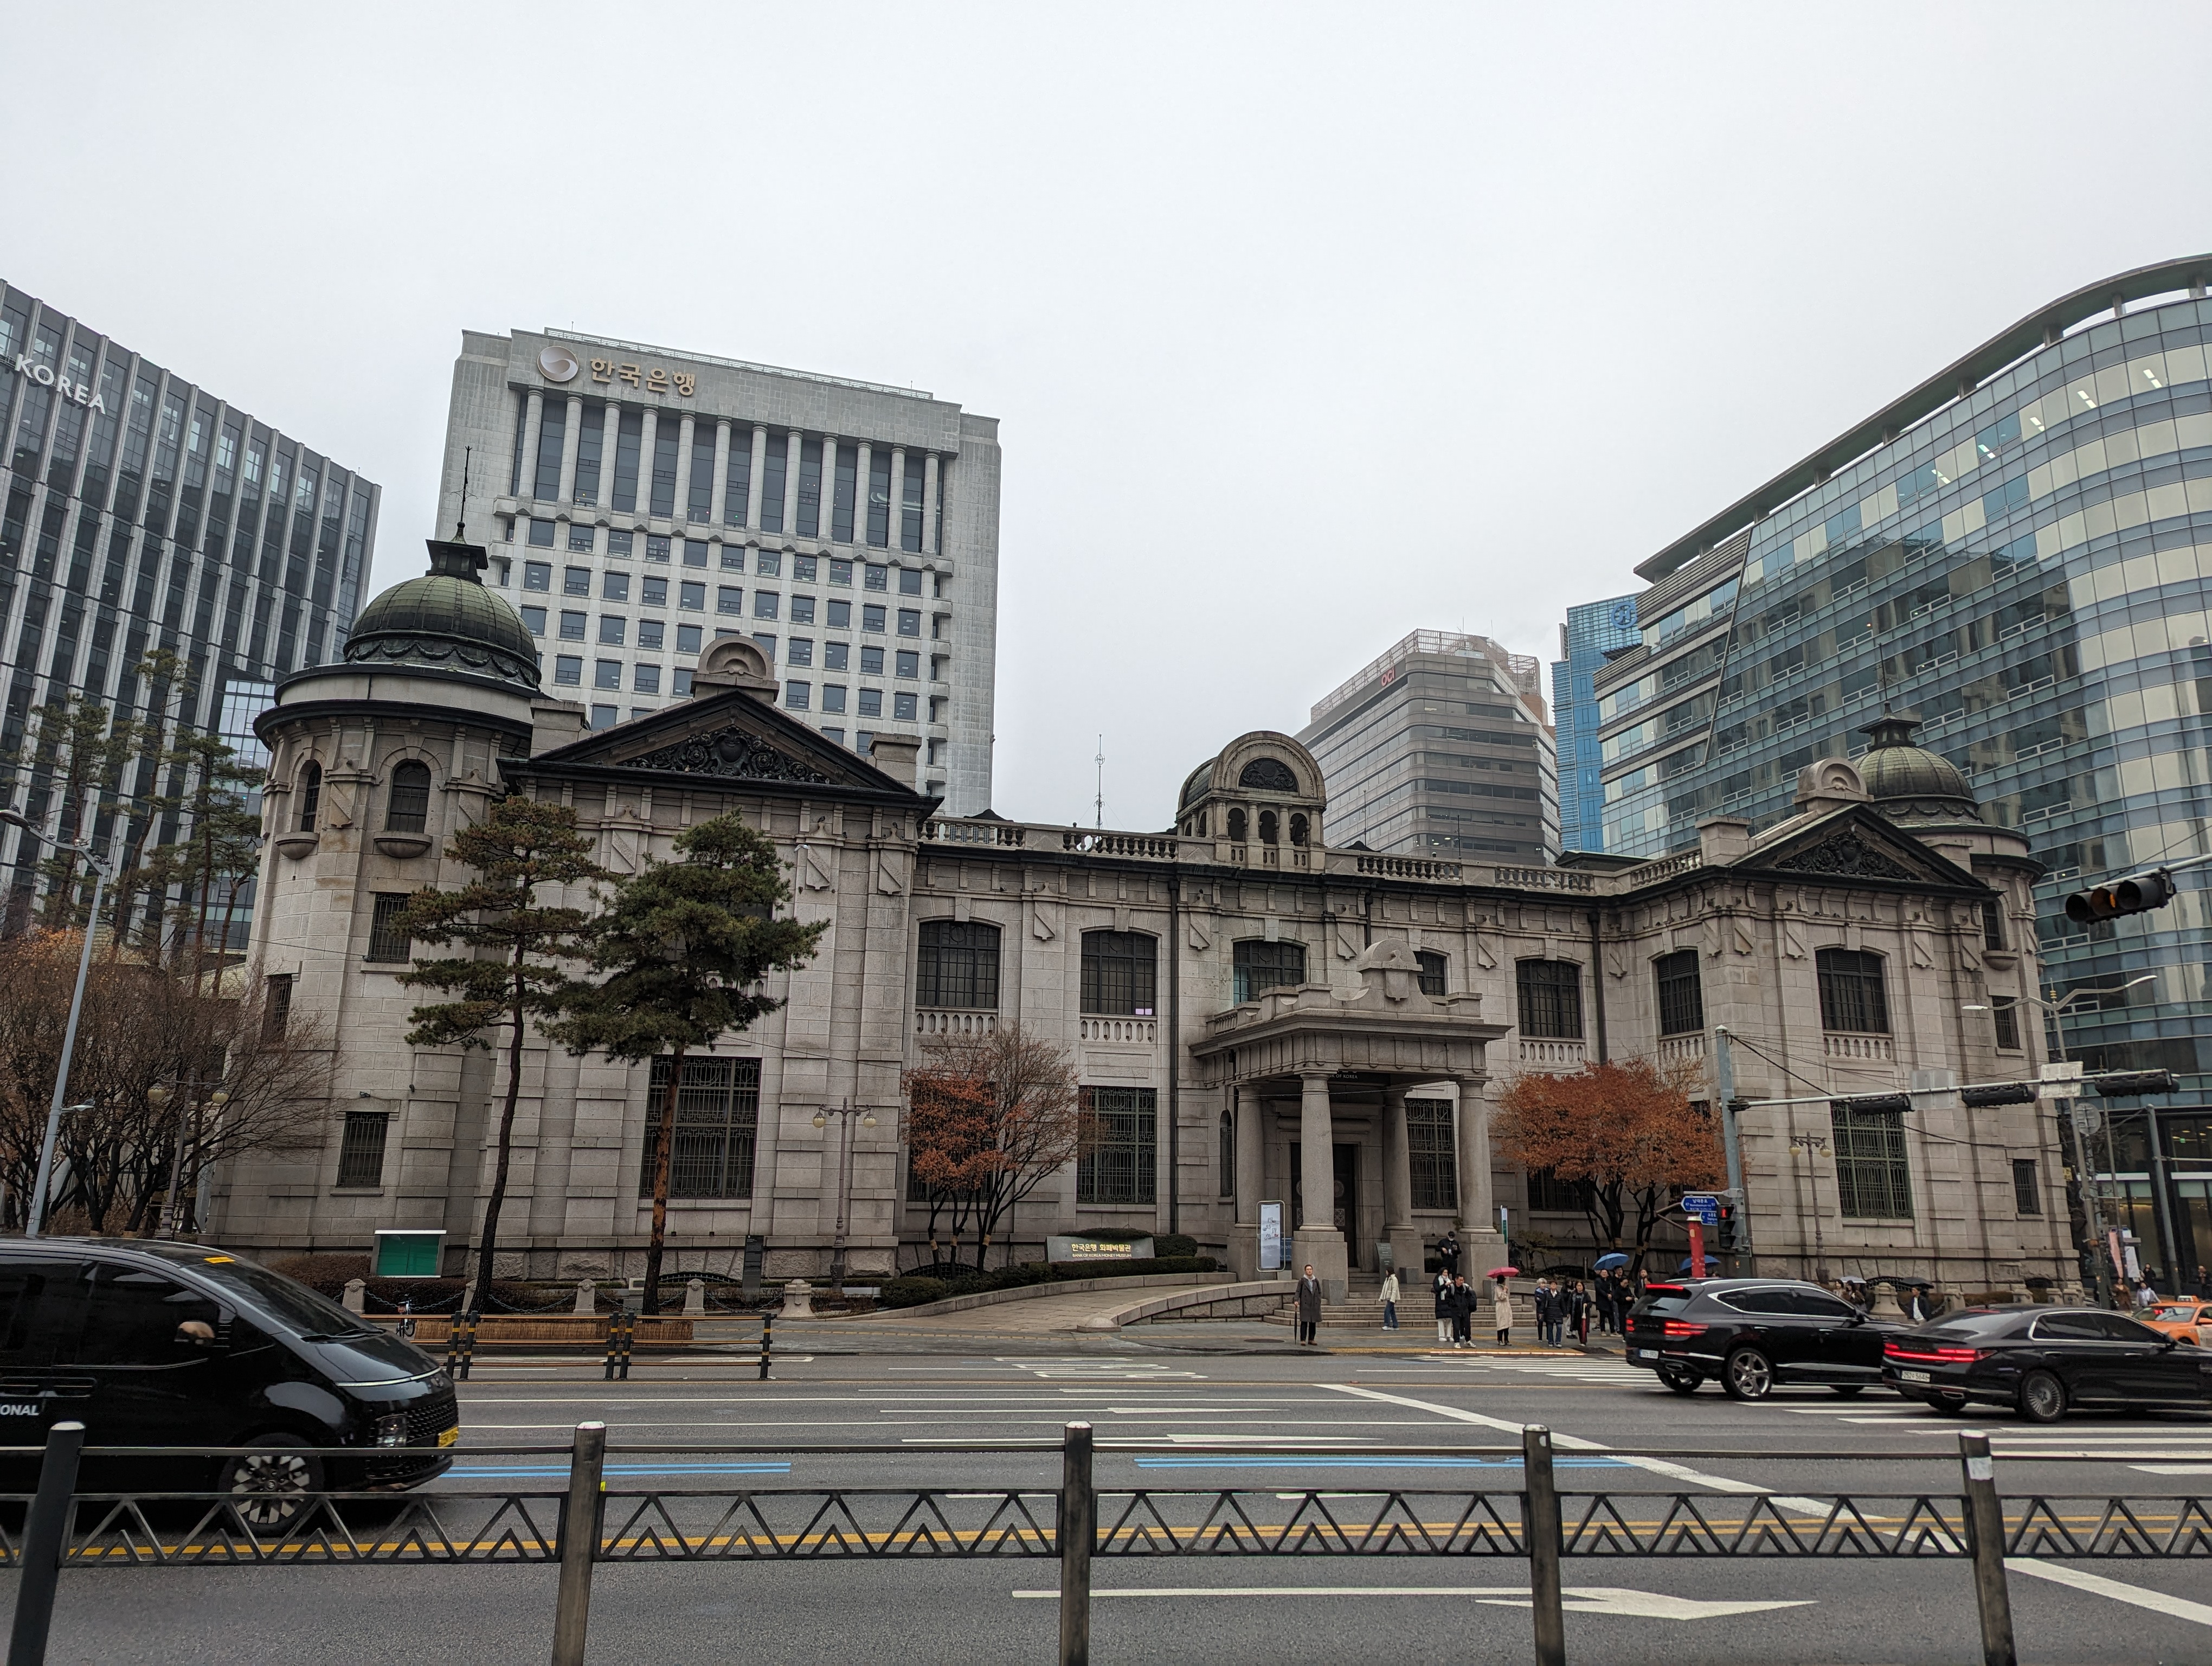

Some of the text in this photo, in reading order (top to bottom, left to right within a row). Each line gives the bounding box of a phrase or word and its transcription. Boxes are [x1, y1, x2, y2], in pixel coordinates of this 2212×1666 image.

[15, 353, 106, 415] KOREA
[590, 358, 695, 395] 한국은행
[1071, 1244, 1131, 1252] 한국은행 화폐박물관
[0, 1405, 40, 1415] ONAL
